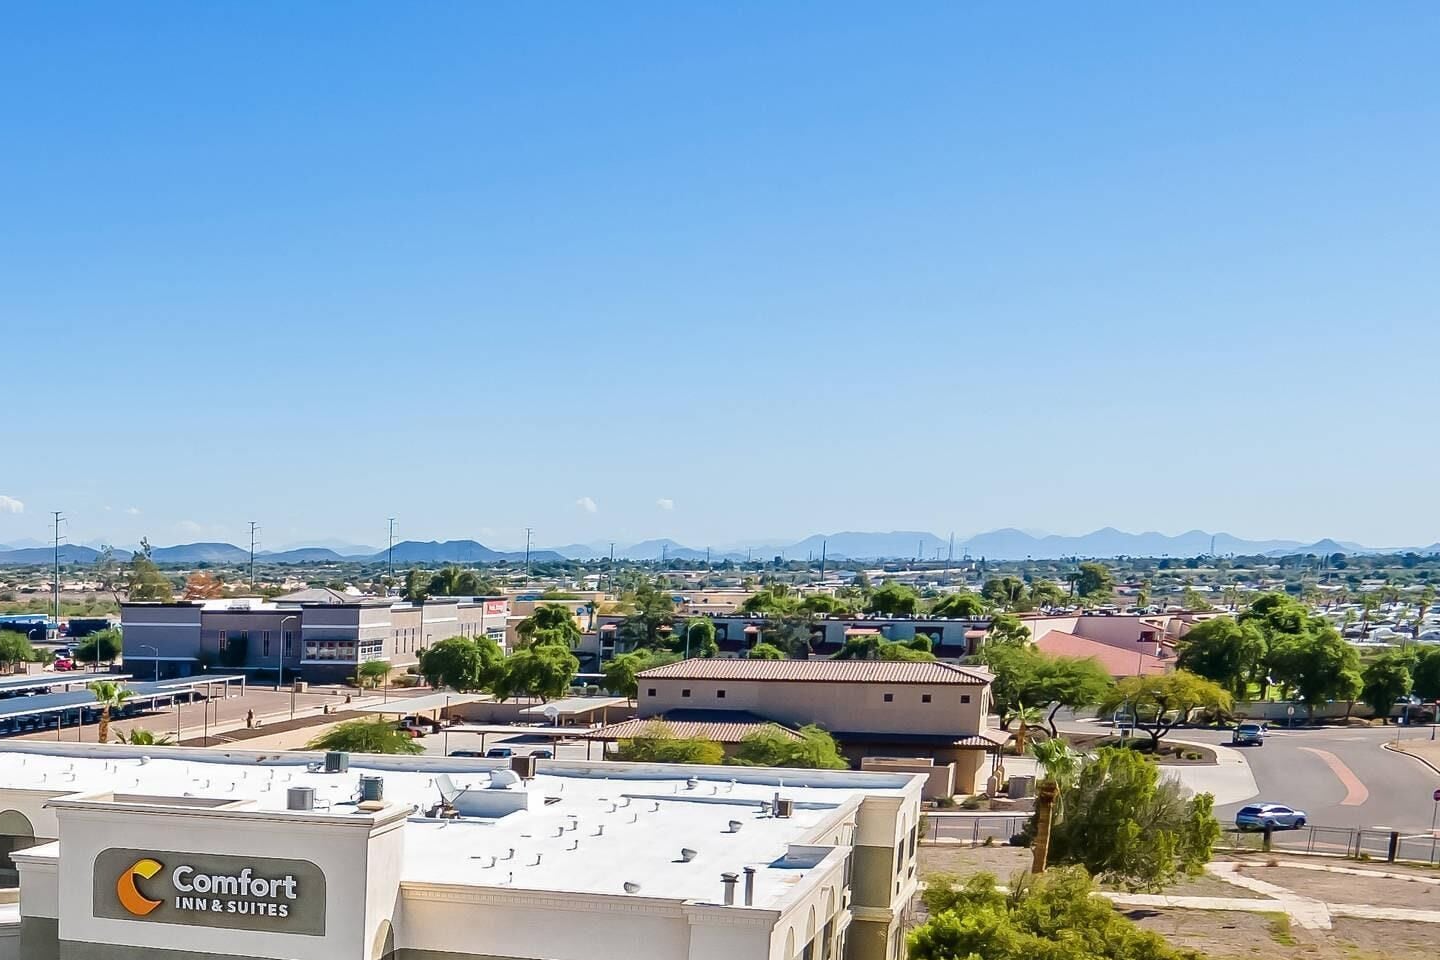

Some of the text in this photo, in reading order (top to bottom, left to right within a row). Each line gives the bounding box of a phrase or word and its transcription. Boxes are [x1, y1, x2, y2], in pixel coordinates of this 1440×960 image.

[173, 865, 297, 899] Comfort
[175, 896, 288, 917] INN & SUITES
